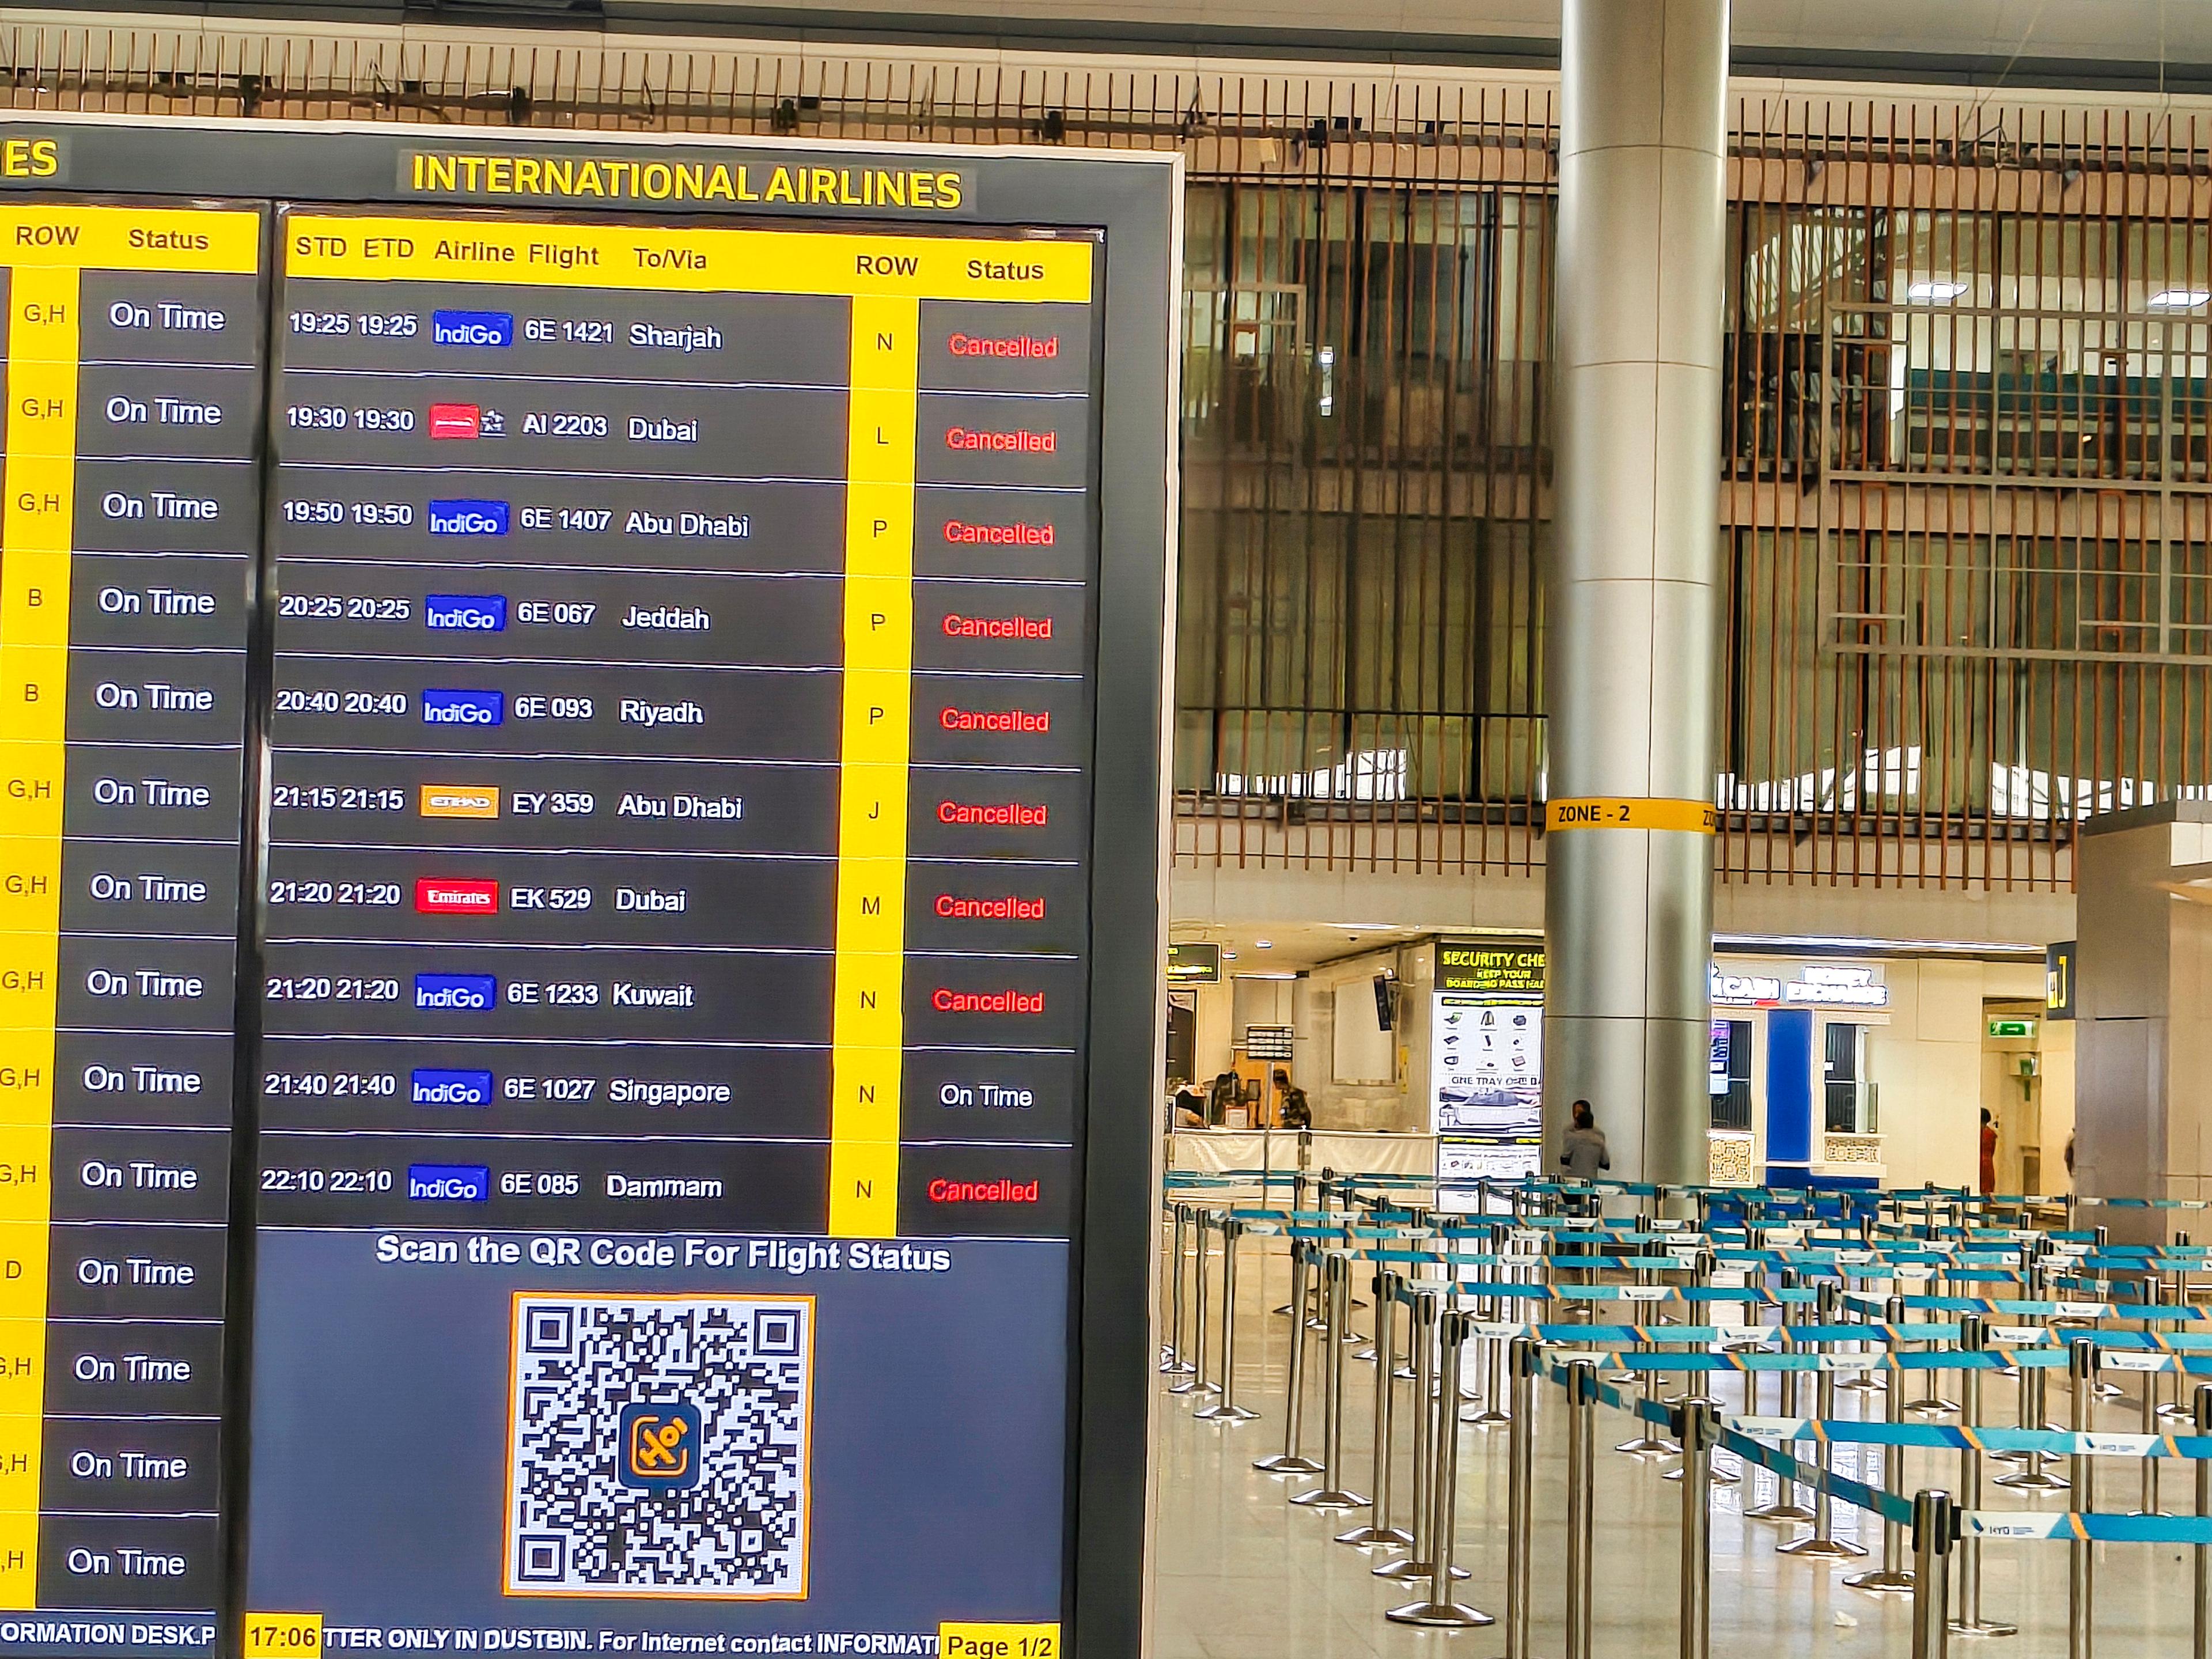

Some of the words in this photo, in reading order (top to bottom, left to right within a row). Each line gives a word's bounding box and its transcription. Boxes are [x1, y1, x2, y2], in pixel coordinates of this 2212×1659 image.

[0, 140, 58, 176] ES
[413, 155, 759, 202] INTERNATIONAL
[766, 166, 962, 209] AIRLINES
[16, 226, 79, 246] ROW
[128, 229, 209, 250] Status
[296, 237, 346, 256] STD
[364, 238, 414, 257] ETD
[435, 240, 515, 262] Airline
[529, 244, 599, 268] Flight
[633, 248, 707, 270] To/Via
[856, 255, 918, 276] ROW
[967, 260, 1044, 280] Status
[25, 305, 65, 325] G,H
[111, 302, 151, 328] On
[158, 303, 225, 331] Time
[291, 312, 350, 335] 19:25
[357, 314, 418, 338] 19:25
[435, 322, 502, 344] IndiGo
[525, 319, 556, 342] 6E
[562, 321, 613, 344] 1421
[630, 324, 722, 352] Sharjah
[877, 332, 892, 351] N
[949, 334, 1059, 358] Cancelled
[21, 399, 63, 419] G,H
[107, 396, 147, 423] On
[154, 397, 221, 424] Time
[287, 407, 347, 427] 19:30
[354, 408, 414, 432] 19:30
[522, 414, 547, 436] AI
[552, 413, 608, 438] 2203
[629, 415, 698, 442] Dubai
[877, 426, 889, 444] L
[946, 427, 1056, 453] Cancelled
[18, 493, 59, 513] G,H
[103, 493, 143, 519] On
[151, 493, 218, 519] Time
[283, 502, 343, 524] 19:50
[351, 502, 412, 525] 19:50
[430, 513, 497, 533] IndiGo
[521, 506, 552, 528] 6E
[558, 508, 612, 531] 1407
[625, 512, 675, 536] Abu
[680, 512, 749, 538] Dhabi
[873, 520, 887, 538] P
[944, 520, 1055, 546] Cancelled
[29, 589, 42, 607] B
[99, 588, 140, 614] On
[146, 589, 215, 615] Time
[279, 596, 342, 618] 20:25
[347, 598, 411, 619] 20:25
[427, 608, 495, 628] IndiGo
[518, 601, 550, 622] 6E
[554, 604, 596, 624] 067
[622, 606, 710, 630] Jeddah
[872, 613, 885, 631] P
[942, 615, 1052, 639] Cancelled
[25, 684, 38, 702] B
[96, 683, 138, 709] On
[144, 684, 213, 710] Time
[276, 691, 339, 712] 20:40
[344, 693, 407, 714] 20:40
[425, 703, 491, 723] IndiGo
[515, 698, 547, 718] 6E
[551, 698, 593, 718] 093
[620, 700, 704, 727] Riyadh
[870, 707, 884, 725] P
[940, 707, 1050, 733] Cancelled
[8, 780, 51, 799] G,H
[94, 779, 134, 805] On
[142, 779, 210, 806] Time
[274, 787, 336, 808] 21:15
[341, 789, 404, 810] 21:15
[513, 793, 547, 814] EY
[551, 793, 594, 813] 359
[617, 794, 666, 817] Abu
[673, 793, 743, 819] Dhabi
[868, 802, 879, 819] J
[938, 800, 1048, 827] Cancelled
[1558, 805, 1601, 822] ZONE
[1619, 805, 1631, 821] 2
[5, 876, 47, 895] G,H
[91, 875, 131, 900] On
[138, 876, 206, 902] Time
[270, 882, 333, 903] 21:20
[338, 884, 401, 904] 21:20
[427, 889, 491, 904] Emirates
[511, 889, 545, 908] EK
[549, 889, 592, 909] 529
[616, 886, 687, 912] Dubai
[862, 896, 880, 915] M
[937, 894, 1044, 919] Cancelled
[1442, 951, 1515, 967] SECURITY
[88, 971, 128, 996] On
[135, 971, 203, 997] Time
[267, 978, 331, 999] 21:20
[336, 979, 399, 999] 21:20
[416, 987, 484, 1007] IndiGo
[507, 983, 539, 1003] 6E
[545, 984, 599, 1004] 1233
[613, 983, 694, 1007] Kuwait
[861, 991, 876, 1009] N
[933, 989, 1044, 1013] Cancelled
[265, 1074, 328, 1095] 21:40
[333, 1074, 396, 1096] 21:40
[413, 1082, 480, 1103] IndiGo
[505, 1078, 536, 1099] 6E
[542, 1079, 596, 1100] 1027
[609, 1079, 732, 1107] Singapore
[859, 1085, 874, 1104] N
[941, 1085, 973, 1106] On
[979, 1082, 1033, 1107] Time
[262, 1170, 324, 1191] 22:10
[329, 1171, 392, 1192] 22:10
[410, 1179, 477, 1199] IndiGo
[501, 1173, 532, 1194] 6E
[537, 1174, 579, 1195] 085
[607, 1175, 724, 1198] Dammam
[857, 1180, 872, 1198] N
[929, 1179, 1039, 1202] Cancelled
[376, 1235, 460, 1263] Scan
[467, 1236, 521, 1265] the
[529, 1238, 582, 1267] QR
[590, 1239, 675, 1267] Code
[684, 1240, 741, 1268] For
[747, 1240, 840, 1275] Flight
[848, 1245, 951, 1271] Status
[0, 1622, 125, 1644] ORMATION
[131, 1624, 216, 1646] DESK.P
[251, 1627, 316, 1647] 17:06
[321, 1628, 382, 1648] TTER
[388, 1629, 451, 1649] ONLY
[455, 1630, 478, 1650] IN
[484, 1627, 593, 1650] DUSTBIN.
[599, 1631, 638, 1651] For
[641, 1632, 726, 1653] Internet
[730, 1633, 813, 1654] contact
[817, 1633, 940, 1656] INFORMATI
[948, 1636, 1008, 1659] Page
[1018, 1637, 1052, 1657] 1/2
